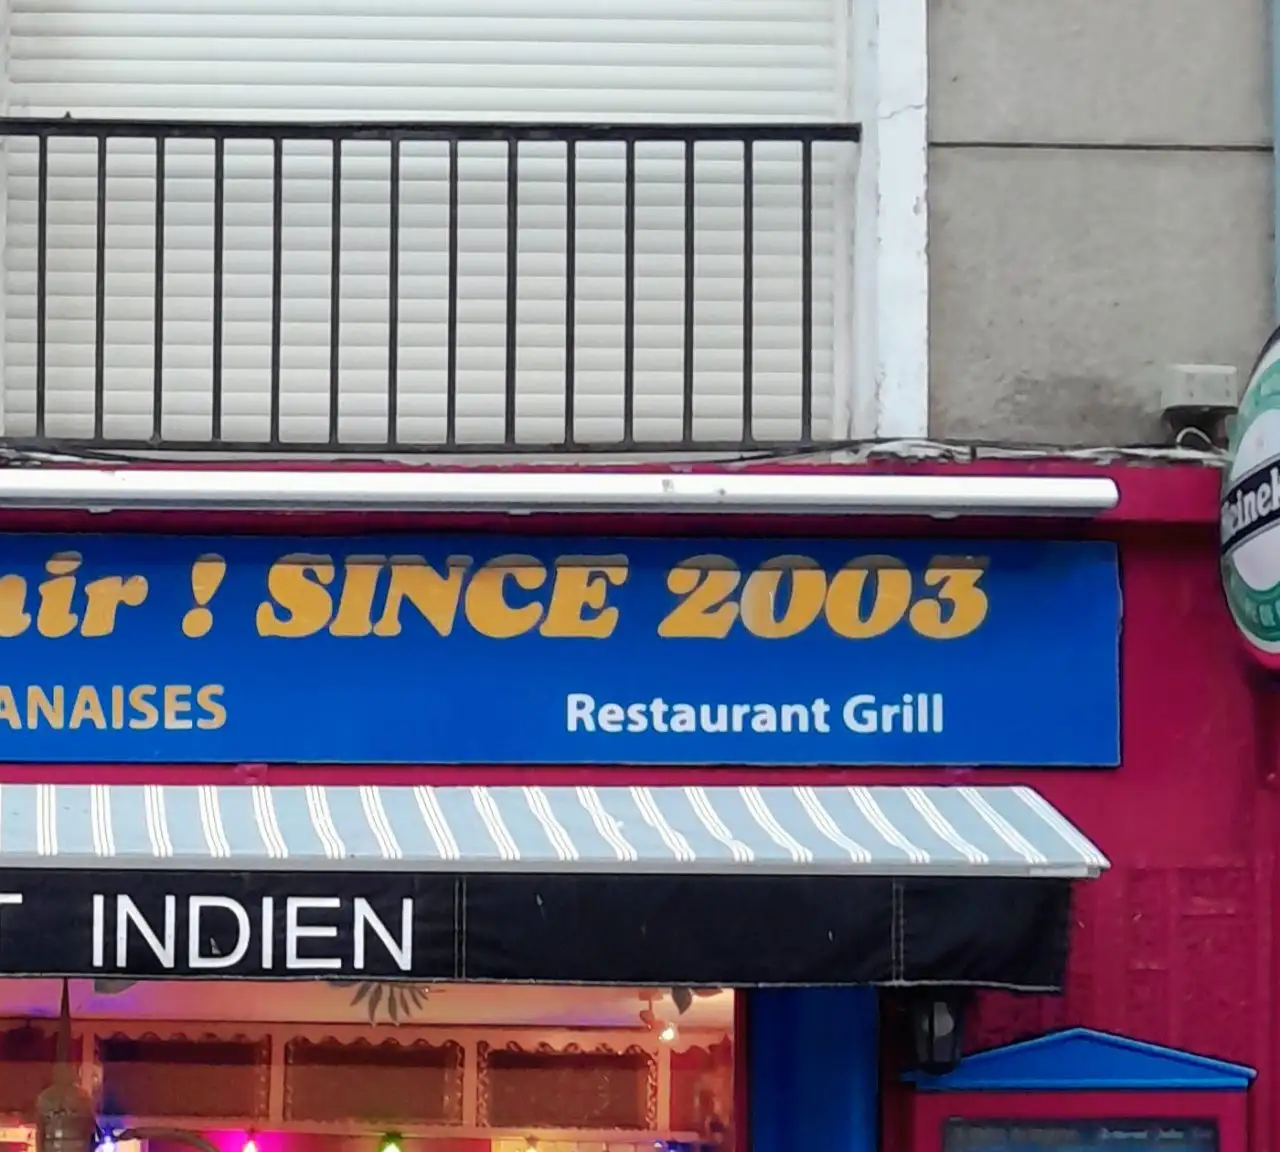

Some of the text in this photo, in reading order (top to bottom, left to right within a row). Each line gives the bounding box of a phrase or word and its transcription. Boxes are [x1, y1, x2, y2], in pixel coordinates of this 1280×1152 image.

[181, 555, 226, 638] !
[256, 554, 629, 639] SINCE
[657, 554, 990, 640] 2003
[566, 693, 944, 735] Restaurant Grill
[91, 894, 414, 971] INDIEN
